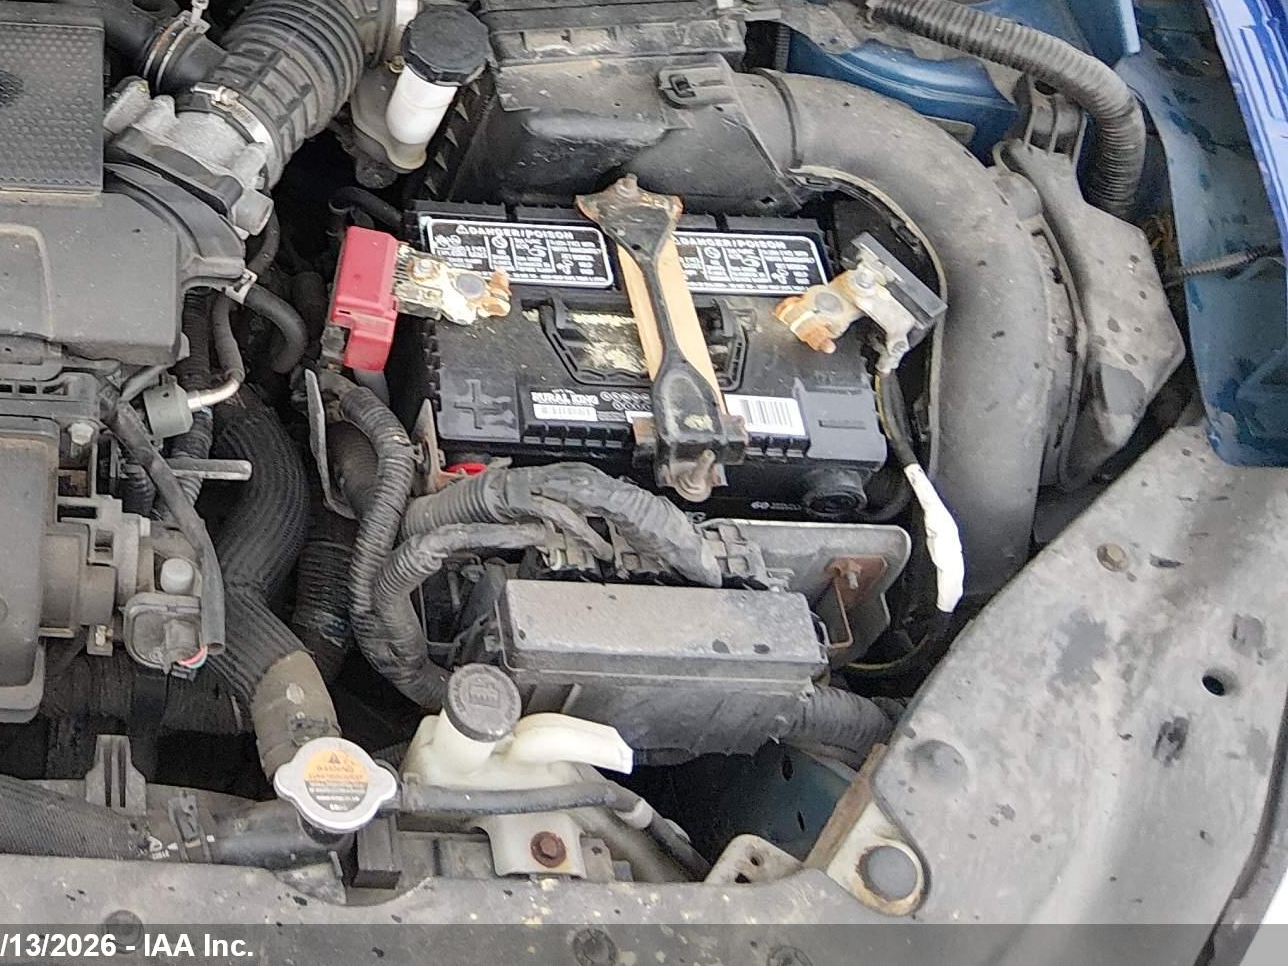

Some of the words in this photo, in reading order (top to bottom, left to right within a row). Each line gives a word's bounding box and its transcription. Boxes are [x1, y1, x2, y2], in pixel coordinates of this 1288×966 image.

[468, 226, 574, 240] DANGER/POISON
[679, 236, 787, 250] DANGER/POISON
[530, 391, 571, 405] RURAL
[570, 393, 600, 407] KING
